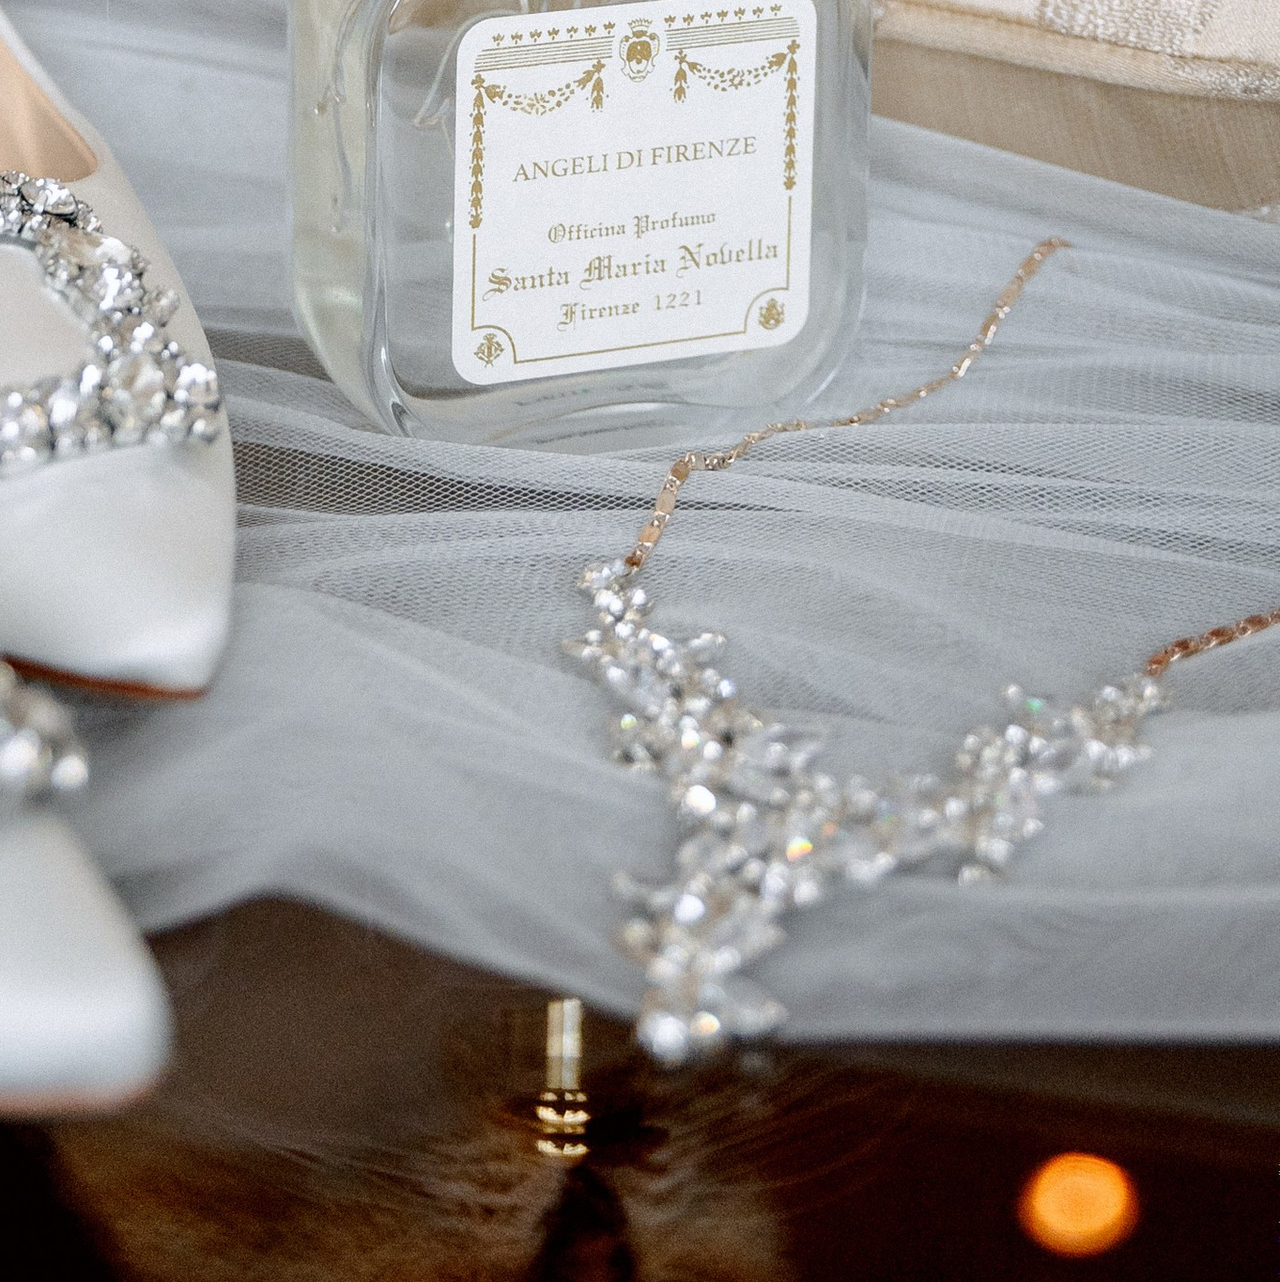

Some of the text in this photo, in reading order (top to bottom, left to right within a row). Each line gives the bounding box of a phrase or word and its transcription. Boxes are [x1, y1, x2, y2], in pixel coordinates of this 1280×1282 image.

[513, 136, 757, 182] ANGELI DI FIRENZE
[548, 212, 716, 244] Officina Profumo
[482, 238, 778, 302] Santa Maria Novella
[556, 290, 703, 332] Firenze 1221
